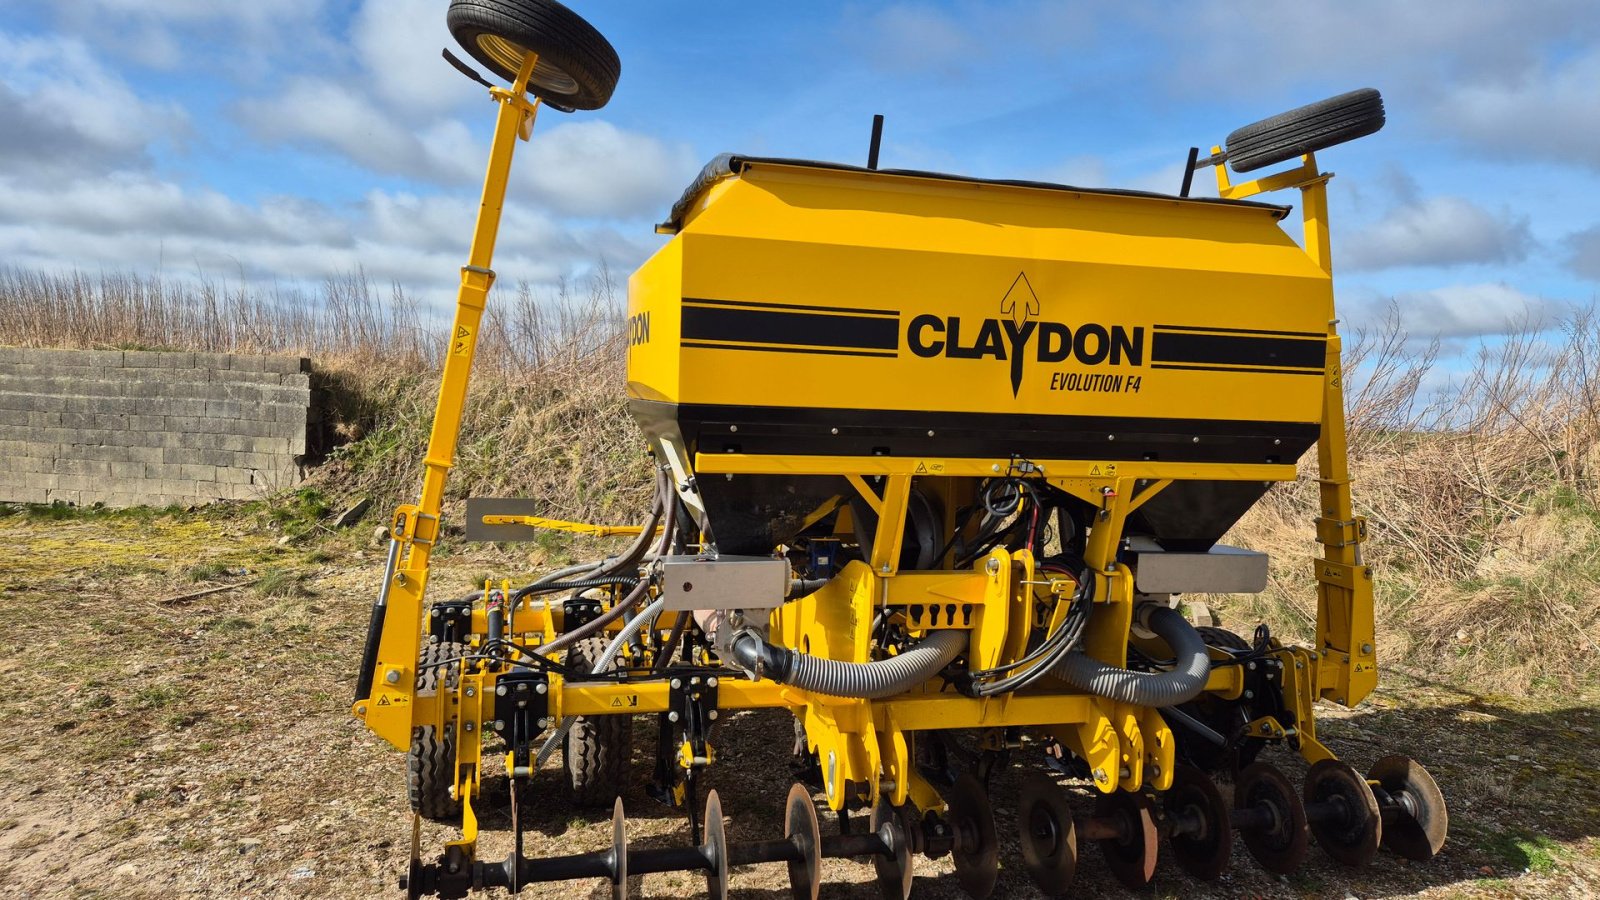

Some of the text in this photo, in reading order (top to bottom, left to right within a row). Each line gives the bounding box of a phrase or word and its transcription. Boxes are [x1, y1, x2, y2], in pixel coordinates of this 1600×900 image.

[907, 314, 1145, 400] CLAYDON
[1050, 372, 1142, 393] EVOLUTION F4
